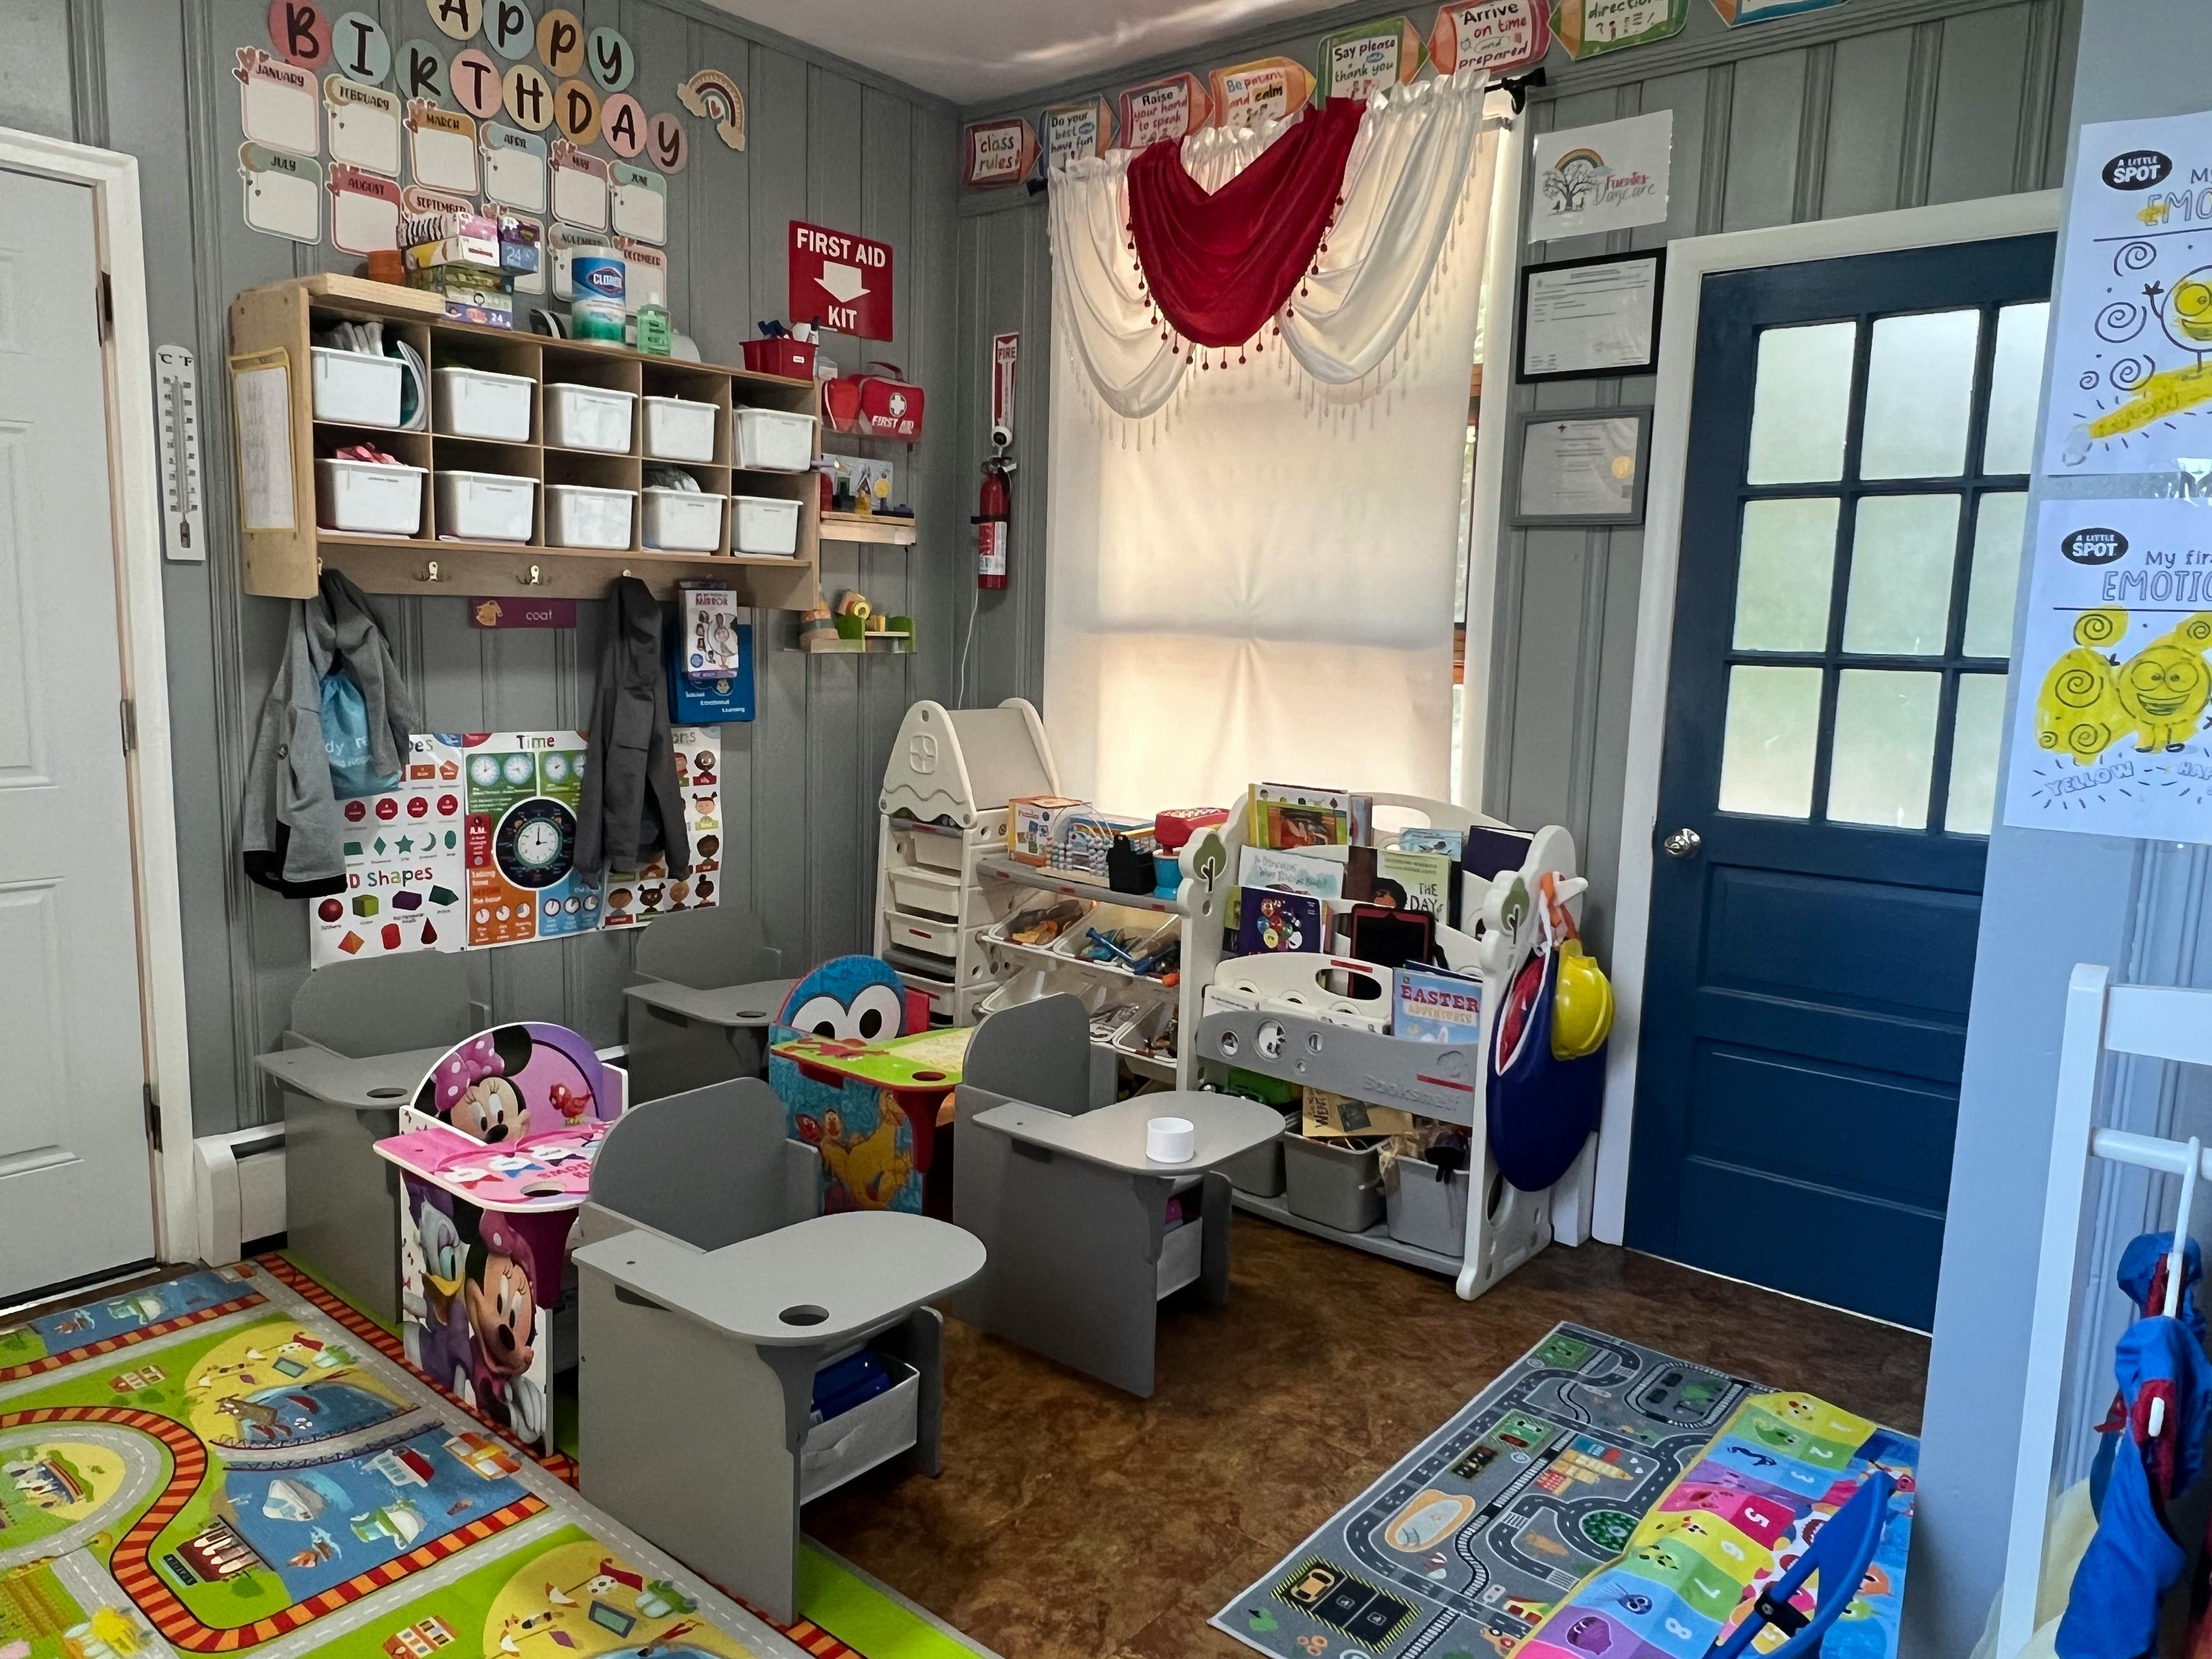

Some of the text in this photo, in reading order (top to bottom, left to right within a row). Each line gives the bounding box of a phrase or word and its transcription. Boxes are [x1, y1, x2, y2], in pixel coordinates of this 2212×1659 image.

[1463, 2, 1519, 25] Arrive
[1474, 15, 1526, 39] on time
[1334, 38, 1396, 61] Say please
[1459, 40, 1528, 70] prepared
[256, 64, 304, 88] JANUARY
[1335, 61, 1393, 83] thank you
[1226, 79, 1242, 92] Be
[1255, 84, 1283, 103] calm
[338, 85, 390, 111] FEBRUARY
[1133, 97, 1187, 123] your hand
[426, 114, 460, 130] MARCH
[1051, 112, 1088, 128] Do your
[1139, 113, 1181, 131] to speak
[980, 134, 1014, 153] class
[1055, 128, 1076, 140] best
[270, 155, 297, 172] JULY
[2128, 156, 2158, 166] LITTLE
[2113, 166, 2159, 183] SPOT
[348, 178, 385, 195] AUGUST
[797, 228, 885, 267] FIRST AID
[492, 312, 503, 323] 24
[828, 305, 857, 329] KIT
[997, 346, 1016, 360] FIRE
[2073, 543, 2118, 557] SPOT
[2145, 550, 2176, 569] My
[526, 609, 552, 620] coat
[516, 735, 555, 750] Time
[2045, 760, 2134, 796] YELLOW
[368, 866, 433, 888] Shapes
[1419, 883, 1438, 896] THE
[1401, 985, 1479, 1013] EASTER
[1745, 1507, 1770, 1528] 5
[1665, 1617, 1693, 1640] 8
